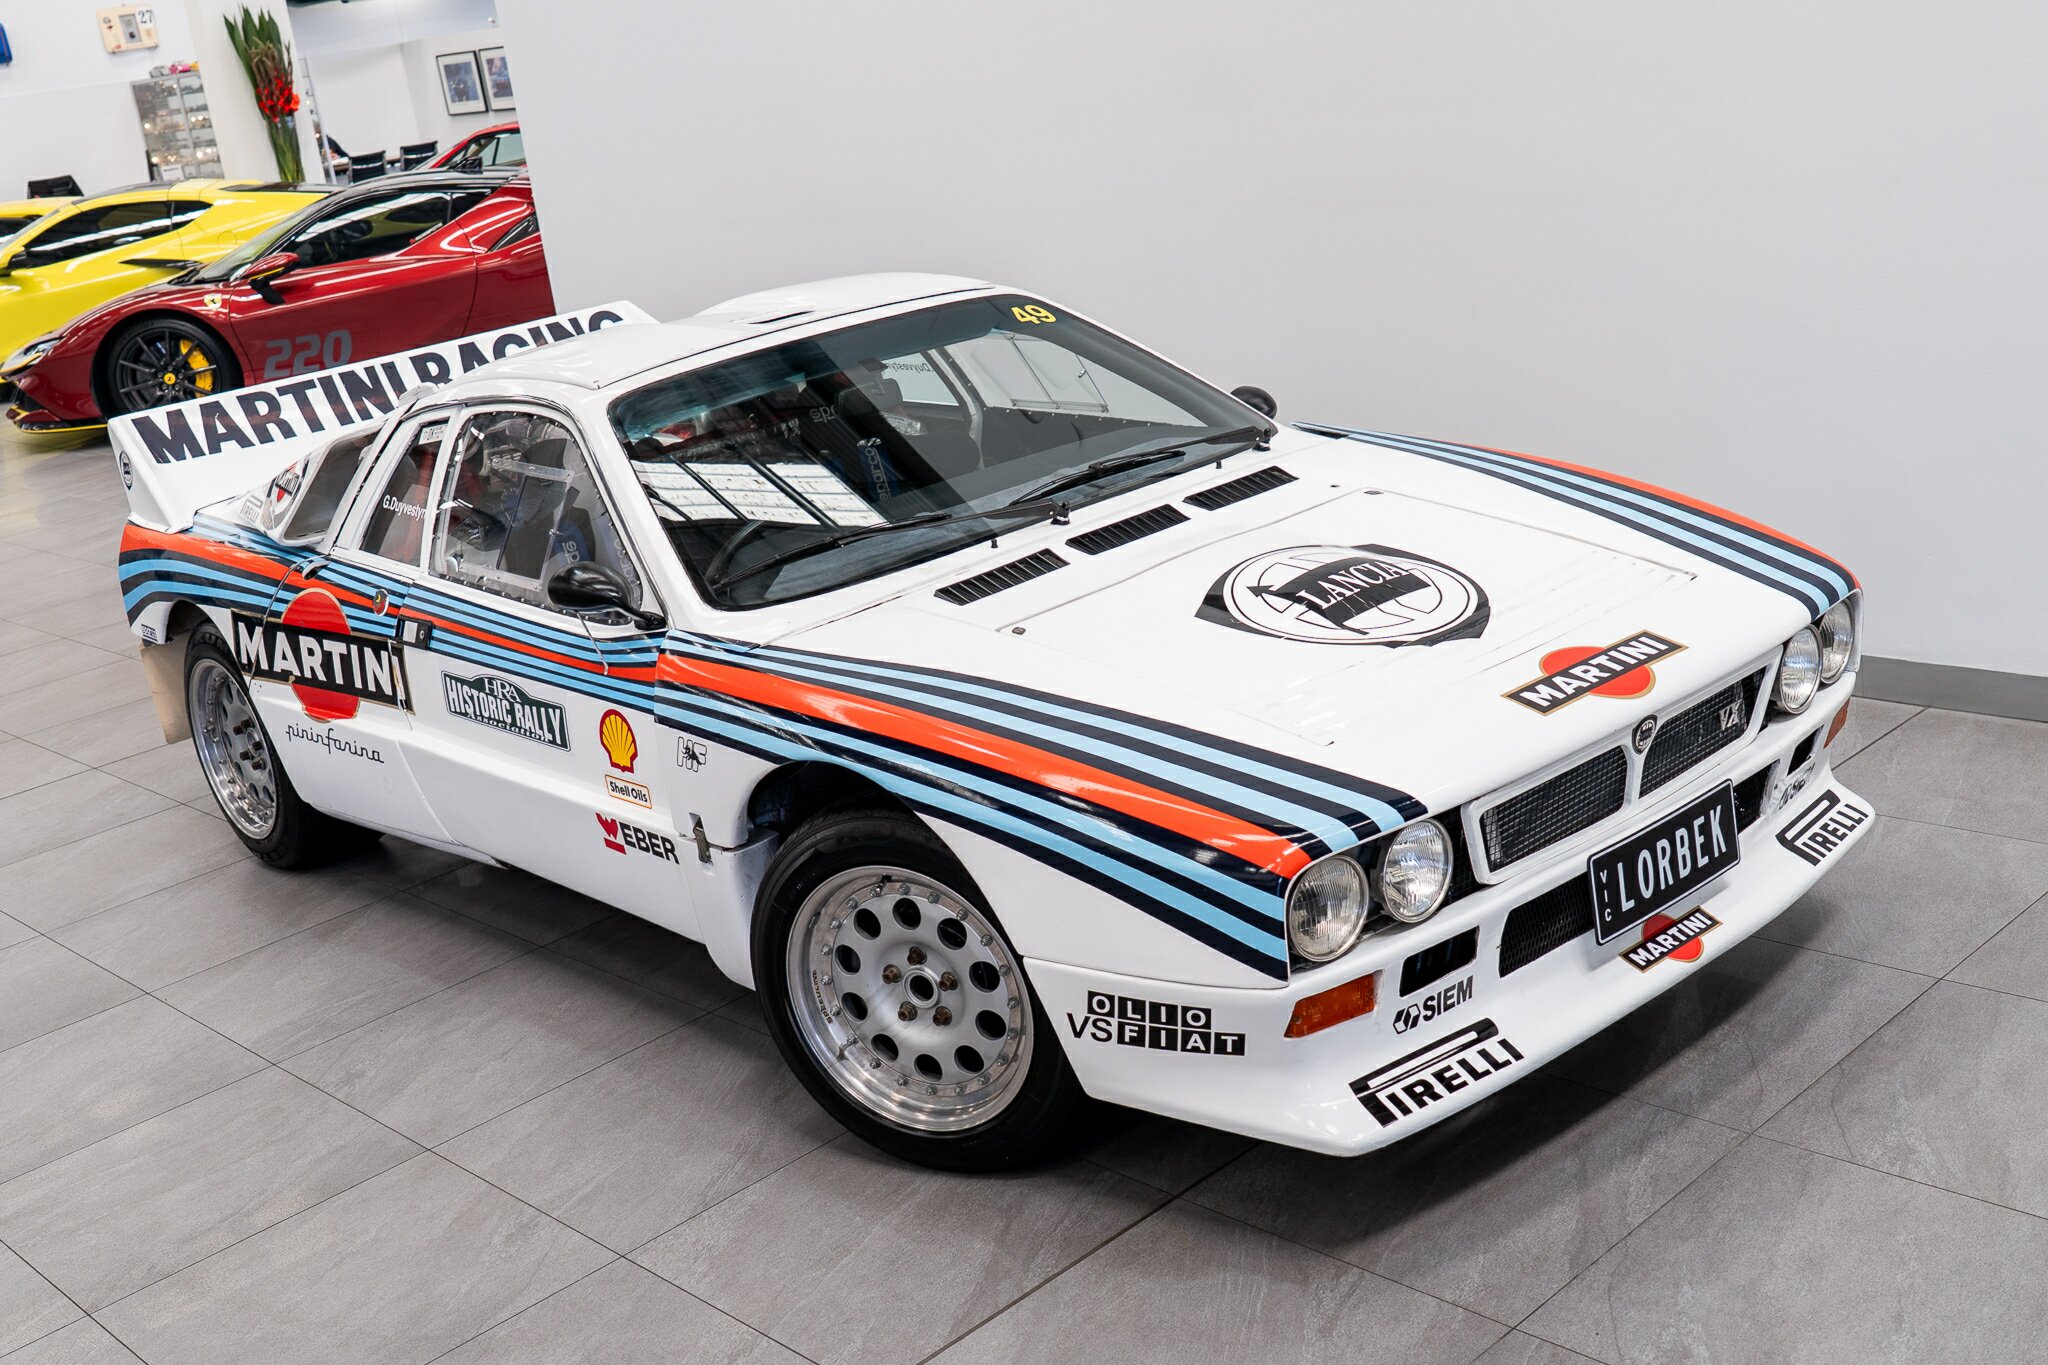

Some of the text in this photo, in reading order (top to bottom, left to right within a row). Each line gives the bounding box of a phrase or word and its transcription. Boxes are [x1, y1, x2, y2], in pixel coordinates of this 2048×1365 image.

[138, 10, 153, 24] 27
[1011, 305, 1057, 324] 49
[263, 329, 352, 379] 220
[131, 361, 408, 464] MARTINI
[1296, 561, 1414, 609] LANCIA
[238, 622, 405, 699] MARTINI
[1519, 636, 1669, 707] MARTINI
[445, 677, 562, 744] HISTORIC RALLY
[483, 678, 522, 702] HRA
[286, 723, 384, 763] pininfarina
[610, 781, 648, 802] Shell Oils
[595, 812, 680, 865] WEBER
[1775, 789, 1869, 867] PIRELLI
[1617, 805, 1727, 912] LORBEK
[1600, 869, 1612, 922] VIC
[1628, 912, 1712, 967] MARTINI
[1091, 995, 1207, 1027] OLIO
[1422, 975, 1474, 1022] SIEM
[1066, 1012, 1239, 1053] VS FIAT
[1348, 1017, 1525, 1129] PIRELLI
